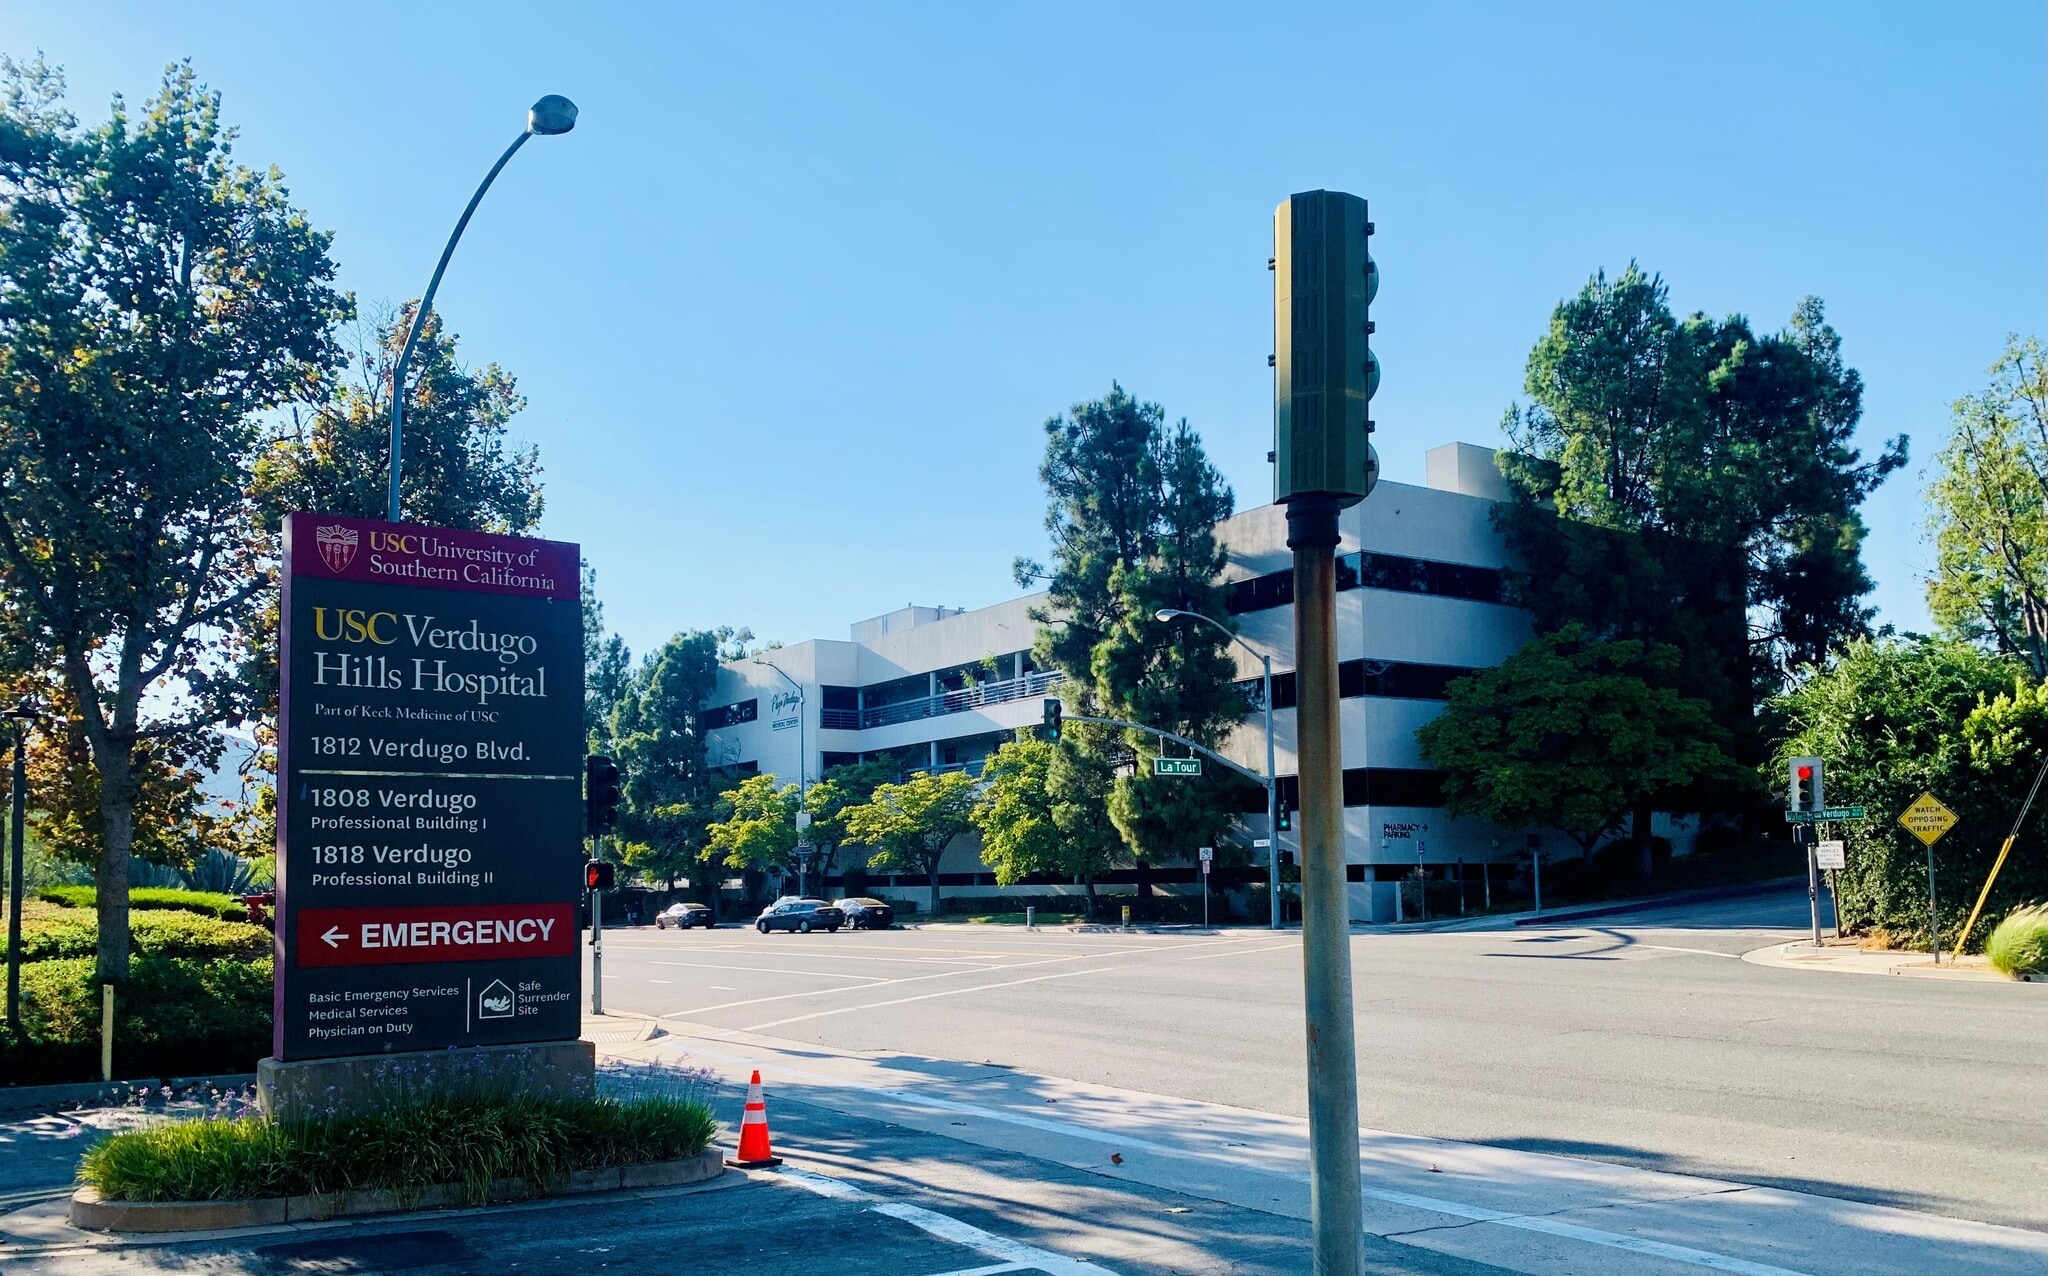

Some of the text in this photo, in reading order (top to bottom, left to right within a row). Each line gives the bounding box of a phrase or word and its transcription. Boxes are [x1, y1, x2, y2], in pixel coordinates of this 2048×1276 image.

[369, 531, 539, 568] USC University of
[369, 554, 555, 591] Southern California
[312, 606, 537, 664] USC Verdugo
[313, 651, 547, 705] Hills Hospital
[314, 703, 500, 723] Part of Keck Medicine of USC
[311, 736, 531, 764] 1812 Verdugo Blvd.
[1160, 761, 1197, 772] La Tour
[311, 788, 477, 813] 1808 Verdugo
[1821, 810, 1850, 820] Verdugo
[1908, 815, 1949, 823] OPPOSING
[311, 816, 487, 833] Professional Building I
[1383, 823, 1419, 831] PHARMACY
[1383, 831, 1411, 839] PARKING
[312, 844, 472, 869] 1818 Verdugo
[312, 872, 494, 887] Professional Building II
[361, 918, 555, 948] EMERGENCY
[518, 980, 541, 992] Safe
[309, 985, 459, 1006] Basic Emergency Services
[518, 991, 571, 1005] Surrender
[309, 1005, 408, 1021] Medical Services
[518, 1004, 538, 1016] Site
[309, 1021, 414, 1039] Physician on Duty
